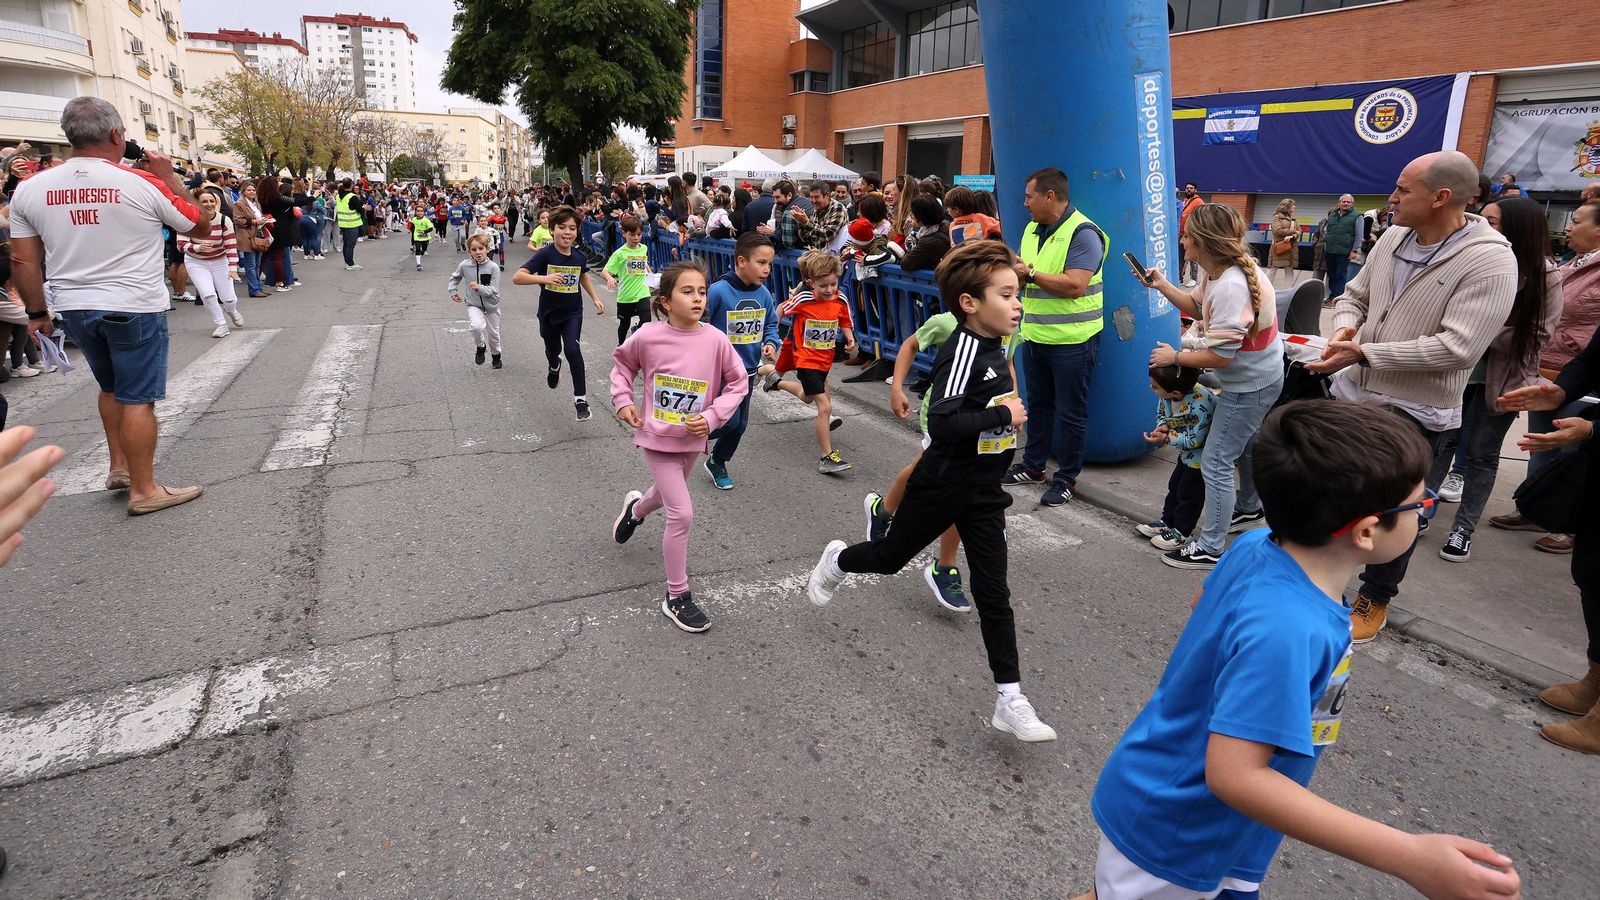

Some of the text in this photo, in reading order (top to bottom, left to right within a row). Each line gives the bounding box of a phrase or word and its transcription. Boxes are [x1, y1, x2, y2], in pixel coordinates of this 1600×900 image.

[1362, 92, 1388, 113] BOMBEROS
[1401, 95, 1413, 121] PROVINCIA
[1511, 106, 1600, 117] AGRUPACIÓN B
[1401, 122, 1409, 130] DE
[47, 188, 121, 206] QUIEN RESISTE
[69, 209, 100, 225] VENCE
[735, 320, 761, 334] 276
[811, 329, 835, 341] 212
[660, 390, 698, 412] 677
